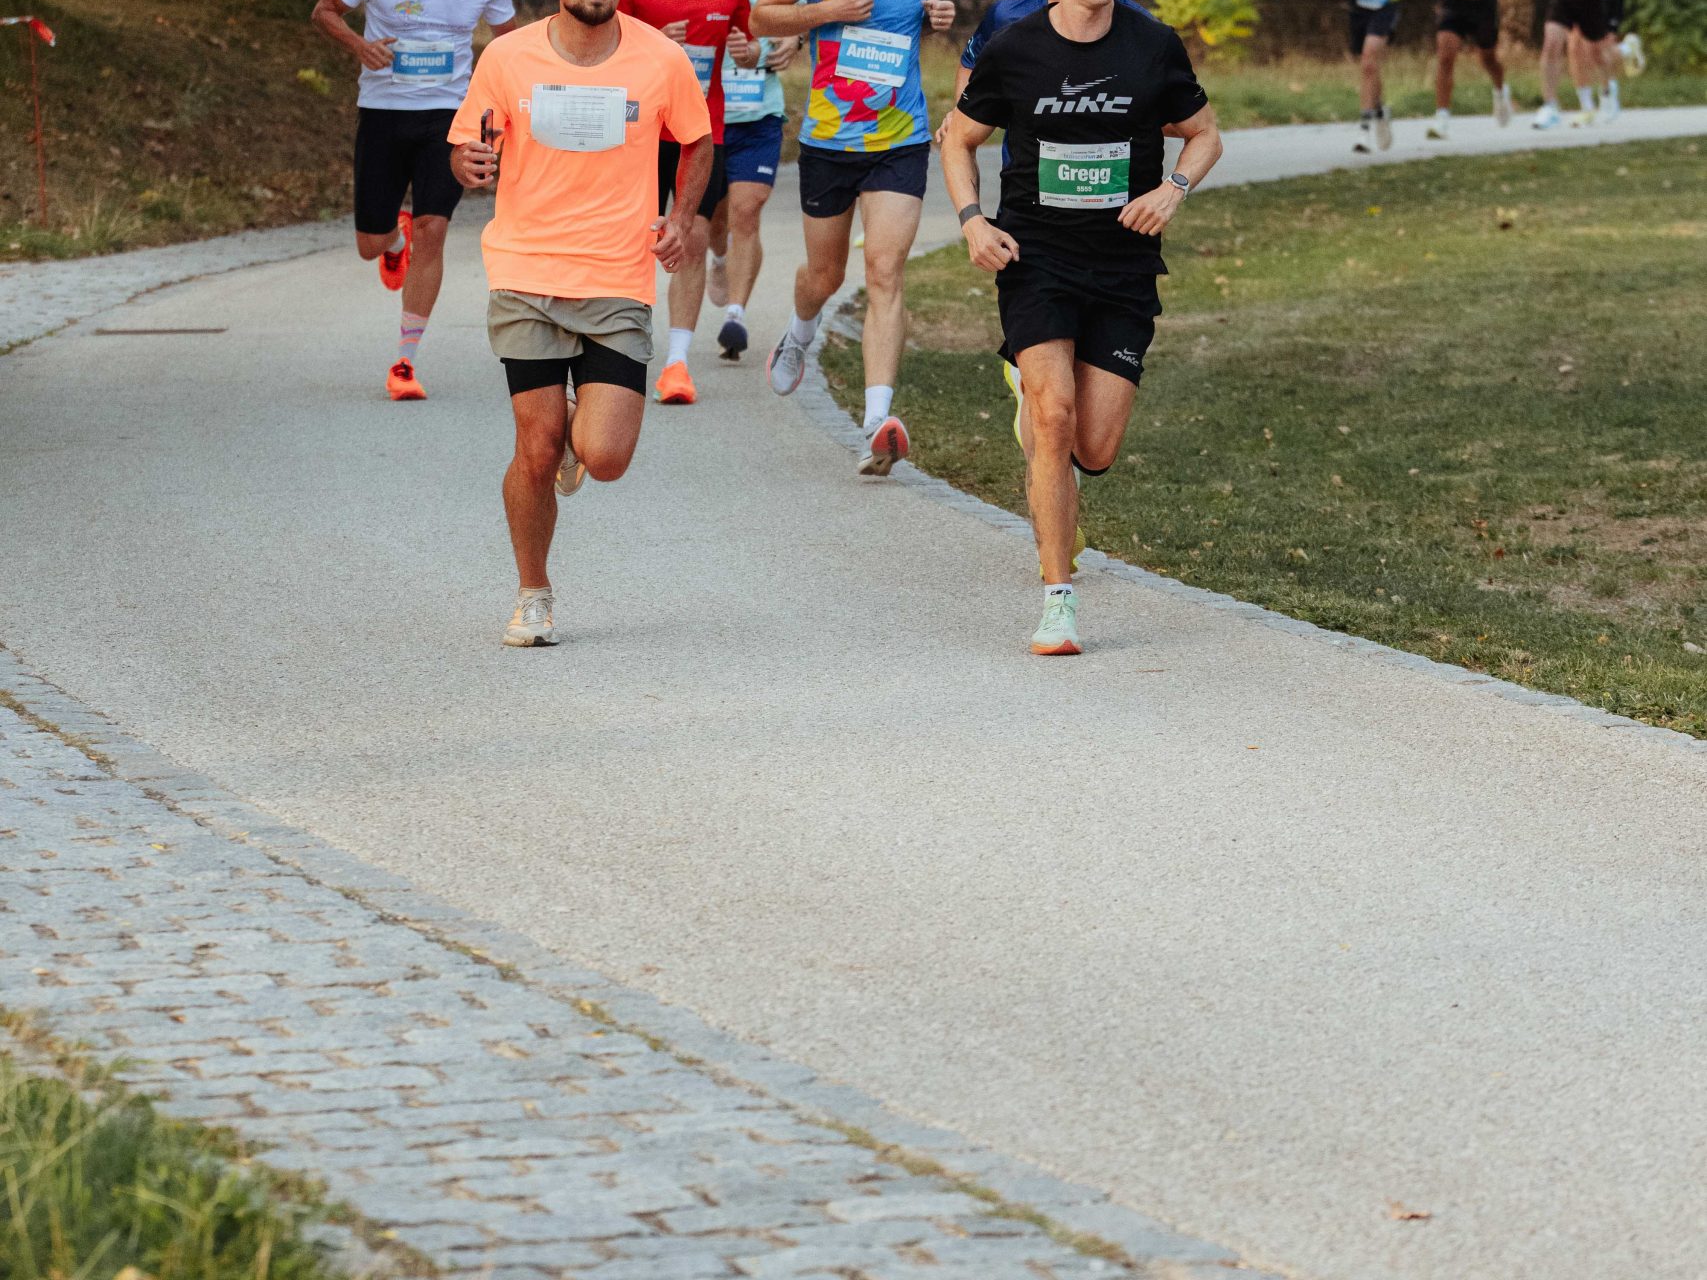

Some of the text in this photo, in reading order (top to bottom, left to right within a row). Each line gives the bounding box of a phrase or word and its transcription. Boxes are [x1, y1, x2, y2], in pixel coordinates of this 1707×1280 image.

[400, 53, 446, 67] Samuel
[846, 43, 903, 68] Anthony
[1058, 164, 1111, 184] Gregg
